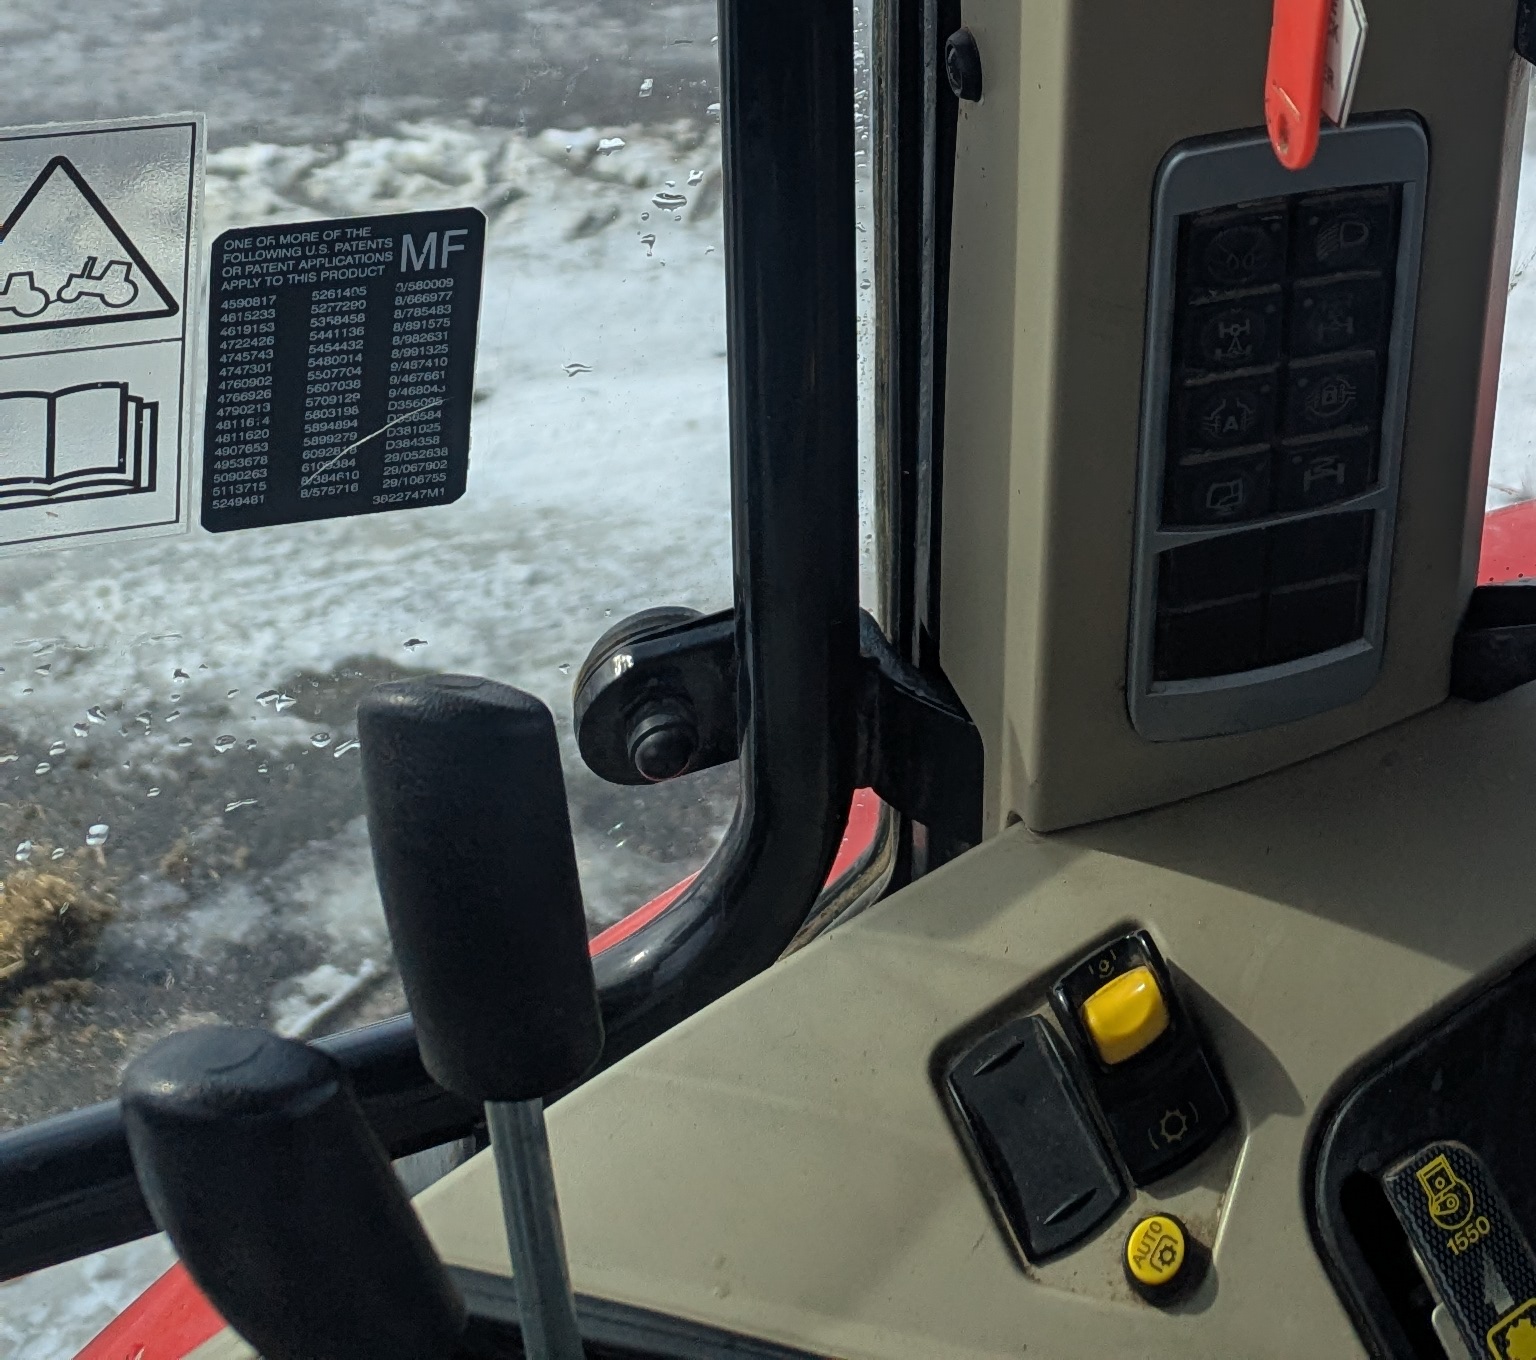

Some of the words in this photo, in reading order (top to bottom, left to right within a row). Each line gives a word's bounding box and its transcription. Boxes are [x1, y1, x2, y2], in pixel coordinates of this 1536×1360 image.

[222, 246, 302, 264] FOLLOWING
[305, 243, 330, 256] U.S.
[334, 238, 393, 253] PATENTS
[224, 237, 252, 251] ONE
[280, 231, 319, 246] MORE
[323, 230, 342, 242] OF
[344, 226, 372, 240] THE
[400, 228, 469, 273] MF
[220, 277, 262, 293] APPLY
[264, 275, 284, 287] TO
[287, 270, 317, 285] THIS
[320, 264, 386, 282] PRODUCT
[222, 265, 242, 278] OR
[245, 260, 296, 275] PATENT
[298, 250, 394, 270] APPLICATIONS
[1133, 1220, 1162, 1269] AUTO
[1446, 1215, 1490, 1256] 1550
